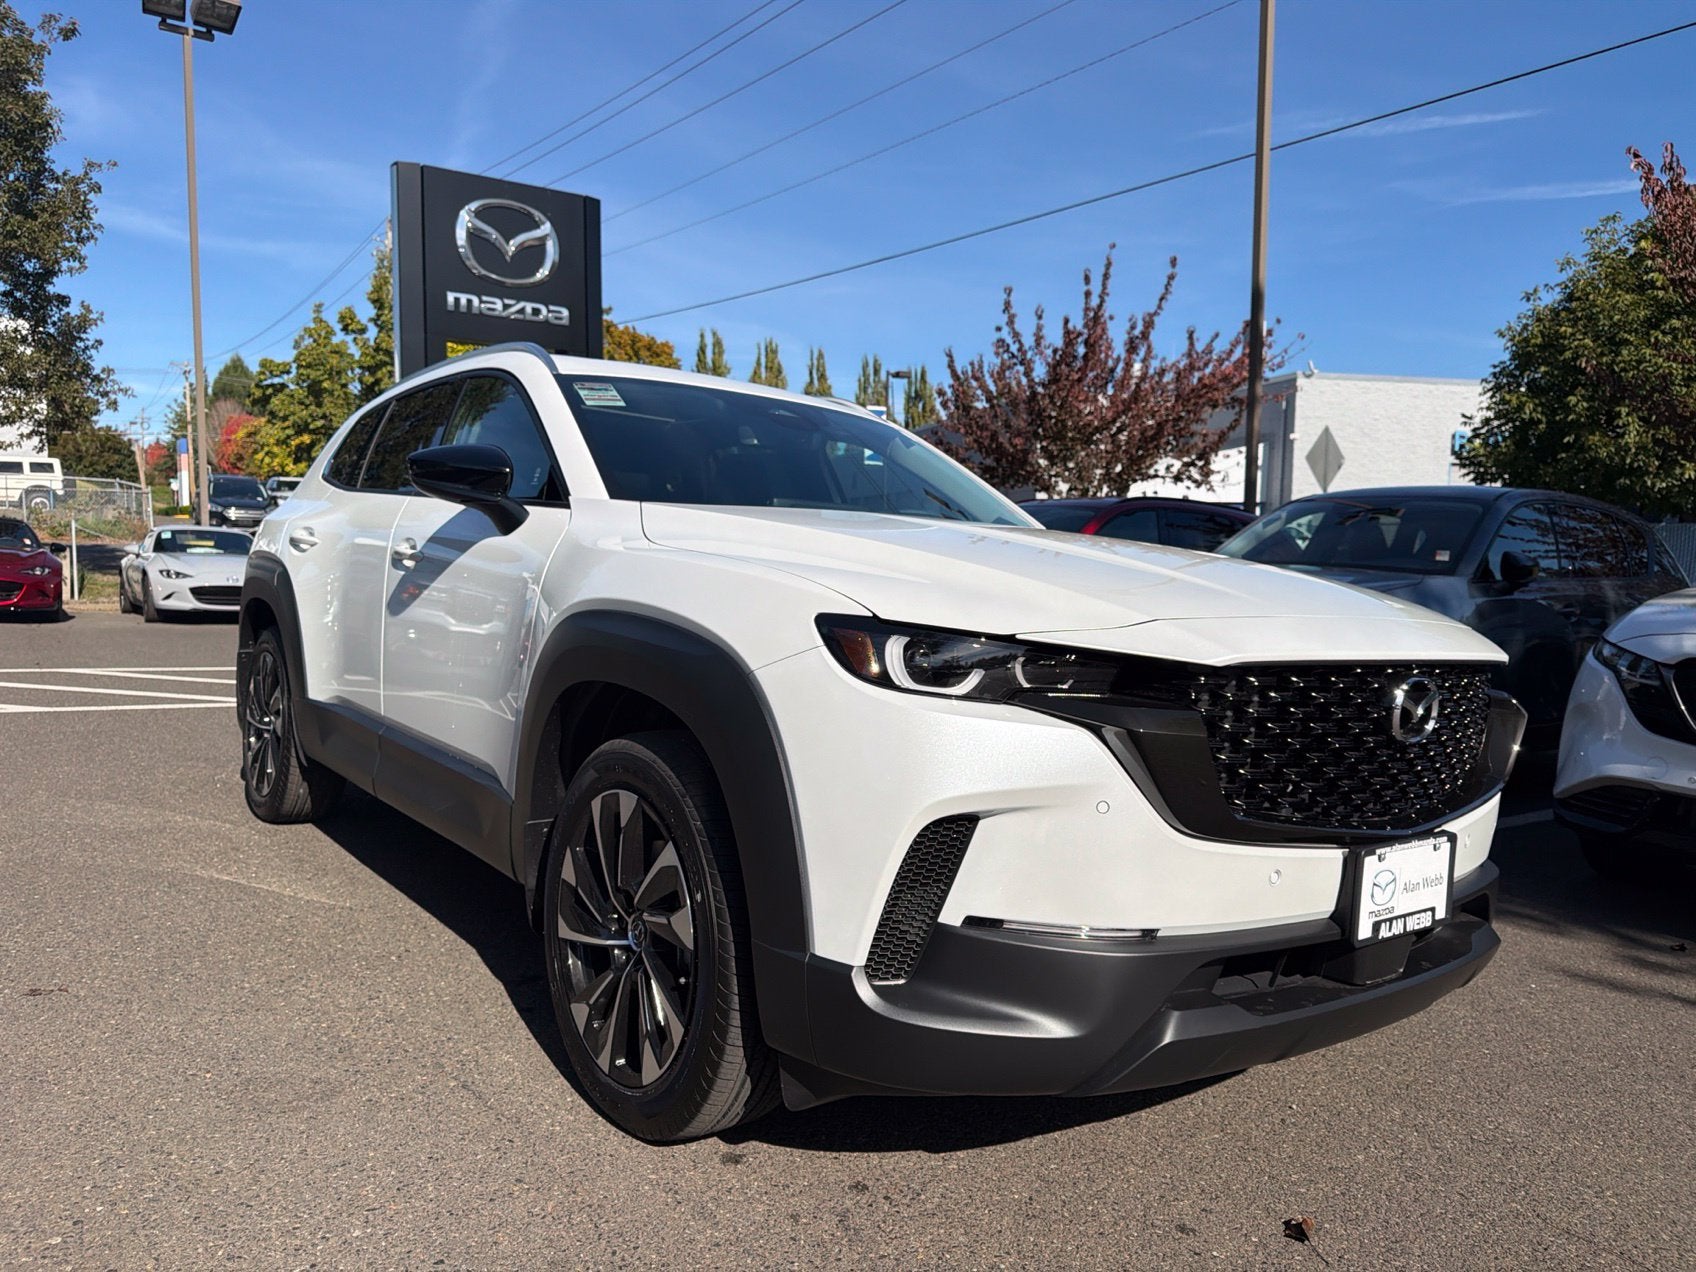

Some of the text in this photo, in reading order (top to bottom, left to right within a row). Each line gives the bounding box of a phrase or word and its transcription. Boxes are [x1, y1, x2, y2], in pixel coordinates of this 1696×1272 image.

[1401, 873, 1444, 895] Alan Webb
[1378, 911, 1432, 939] ALAN WEBB
